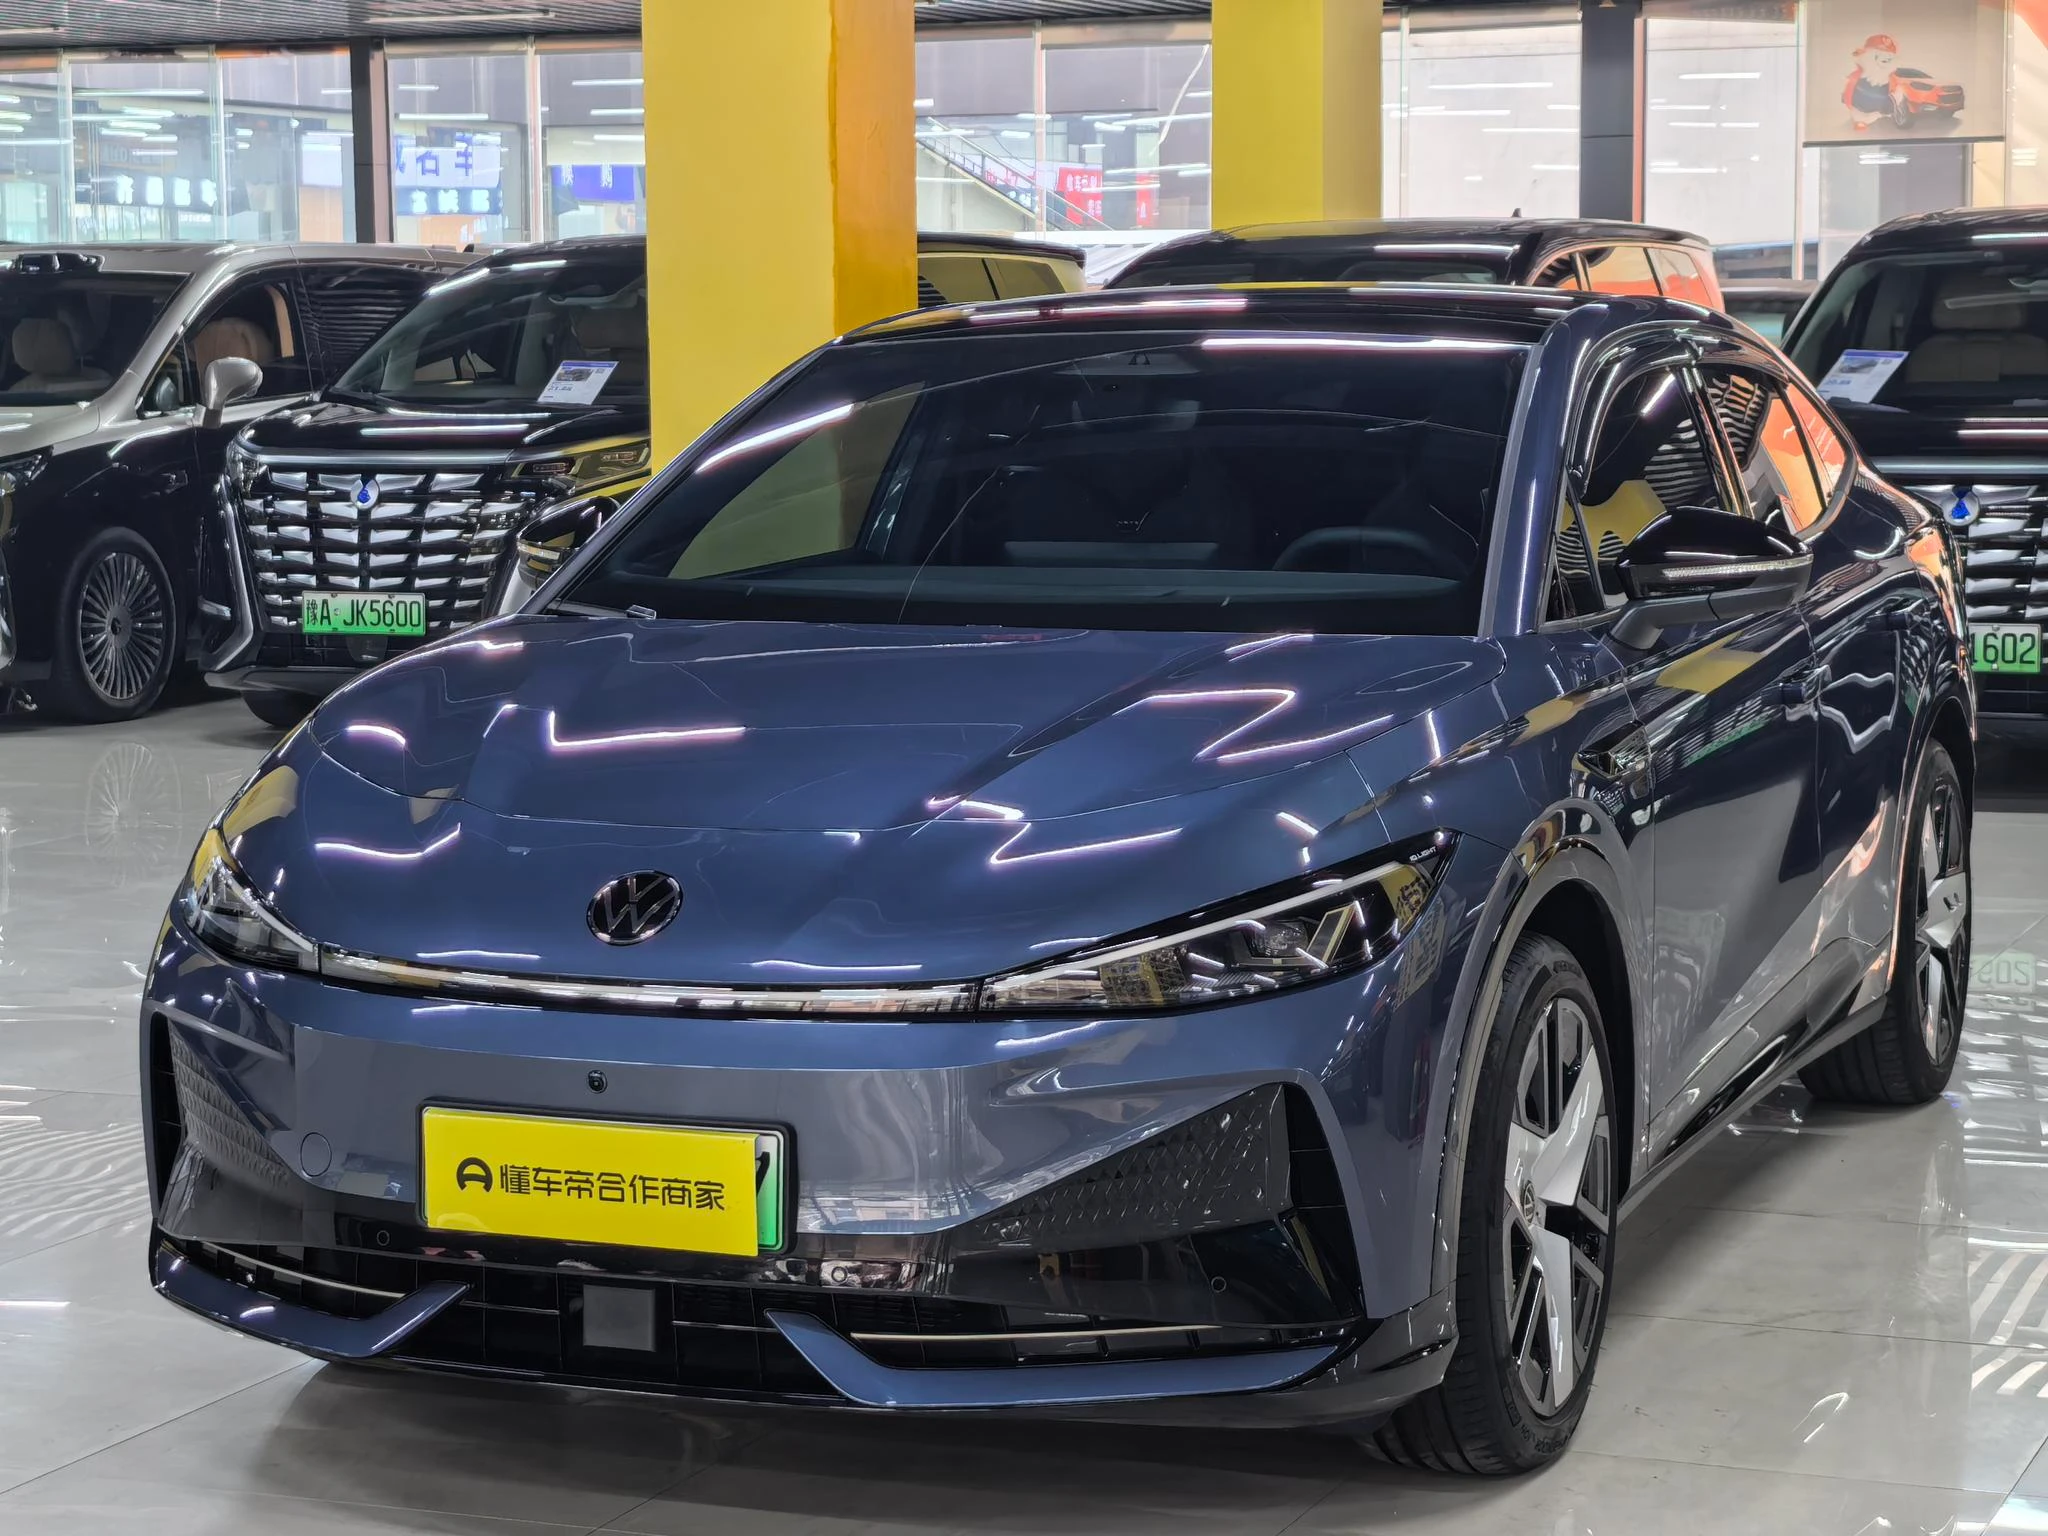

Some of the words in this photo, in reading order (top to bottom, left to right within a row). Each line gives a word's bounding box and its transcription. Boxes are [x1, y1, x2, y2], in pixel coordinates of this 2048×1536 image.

[500, 1163, 725, 1210] 懂车帝合作商家
